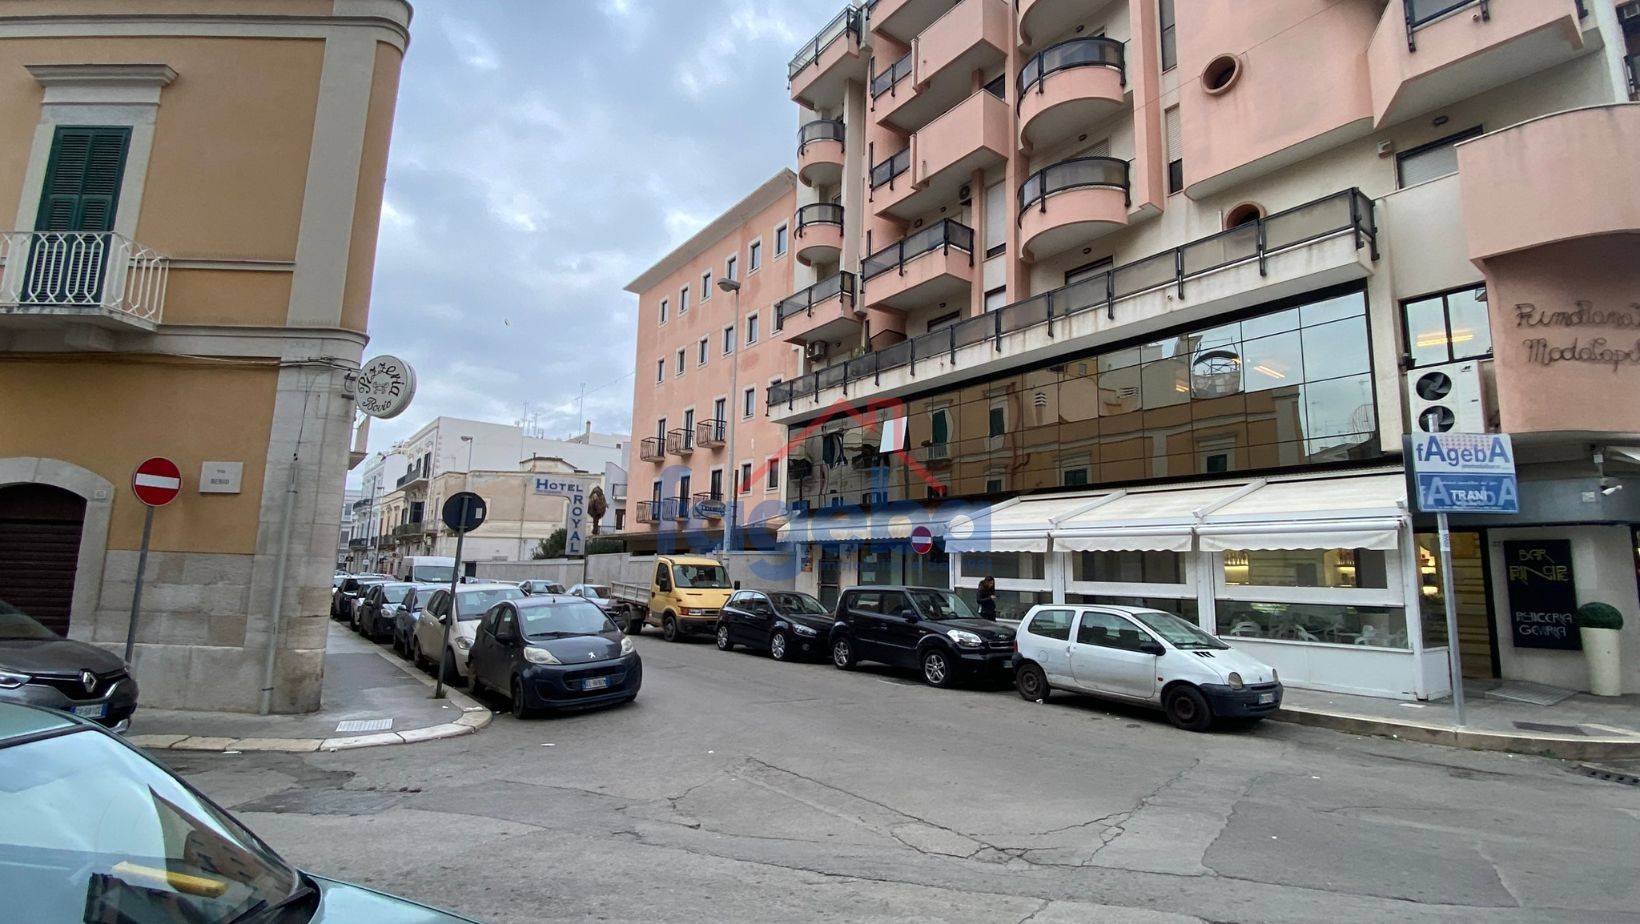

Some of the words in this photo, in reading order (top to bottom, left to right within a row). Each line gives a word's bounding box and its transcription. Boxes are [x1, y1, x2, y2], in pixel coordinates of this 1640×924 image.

[358, 362, 404, 397] Pizzeria
[362, 397, 392, 412] Bovio
[1416, 435, 1511, 467] fAgebA
[1450, 489, 1488, 501] TRANI
[570, 494, 584, 553] ROYAL
